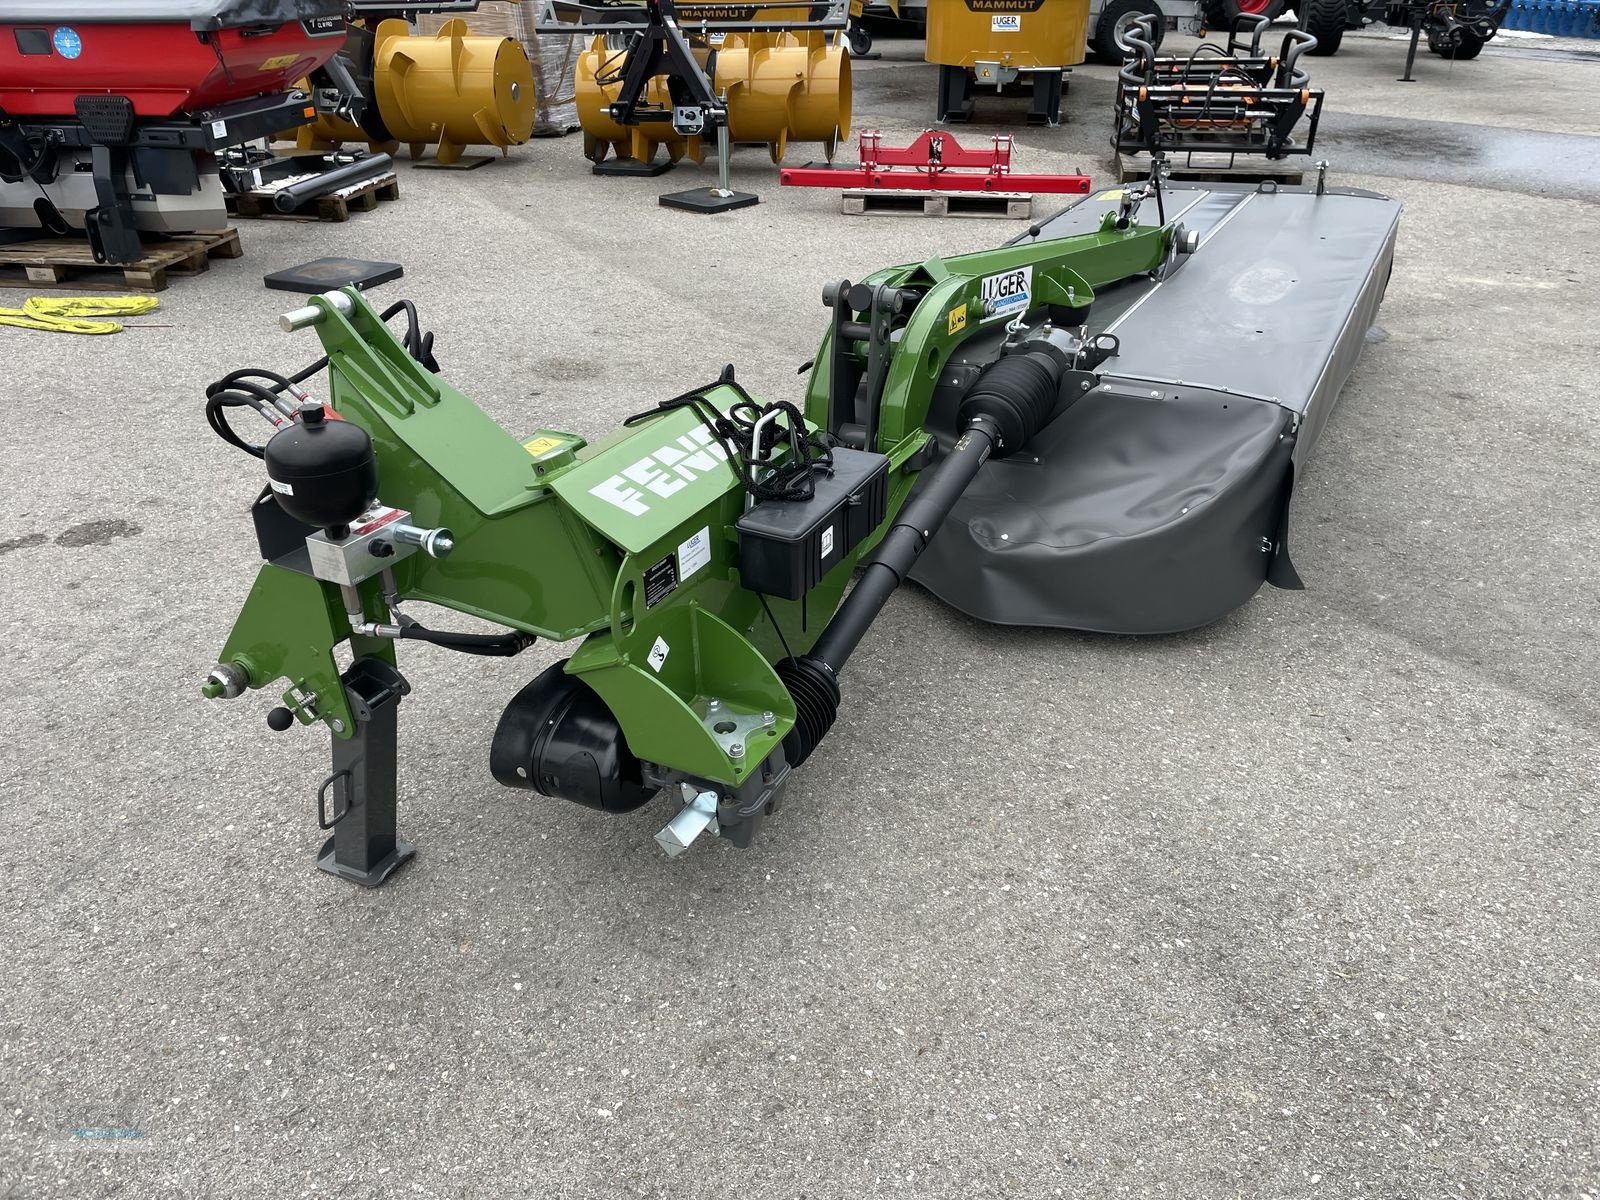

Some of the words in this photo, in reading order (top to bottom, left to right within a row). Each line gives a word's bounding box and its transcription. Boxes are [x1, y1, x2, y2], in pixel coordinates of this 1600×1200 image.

[972, 0, 1036, 9] MAMMUT
[681, 9, 748, 18] MAMMUT
[993, 16, 1017, 25] LUGER
